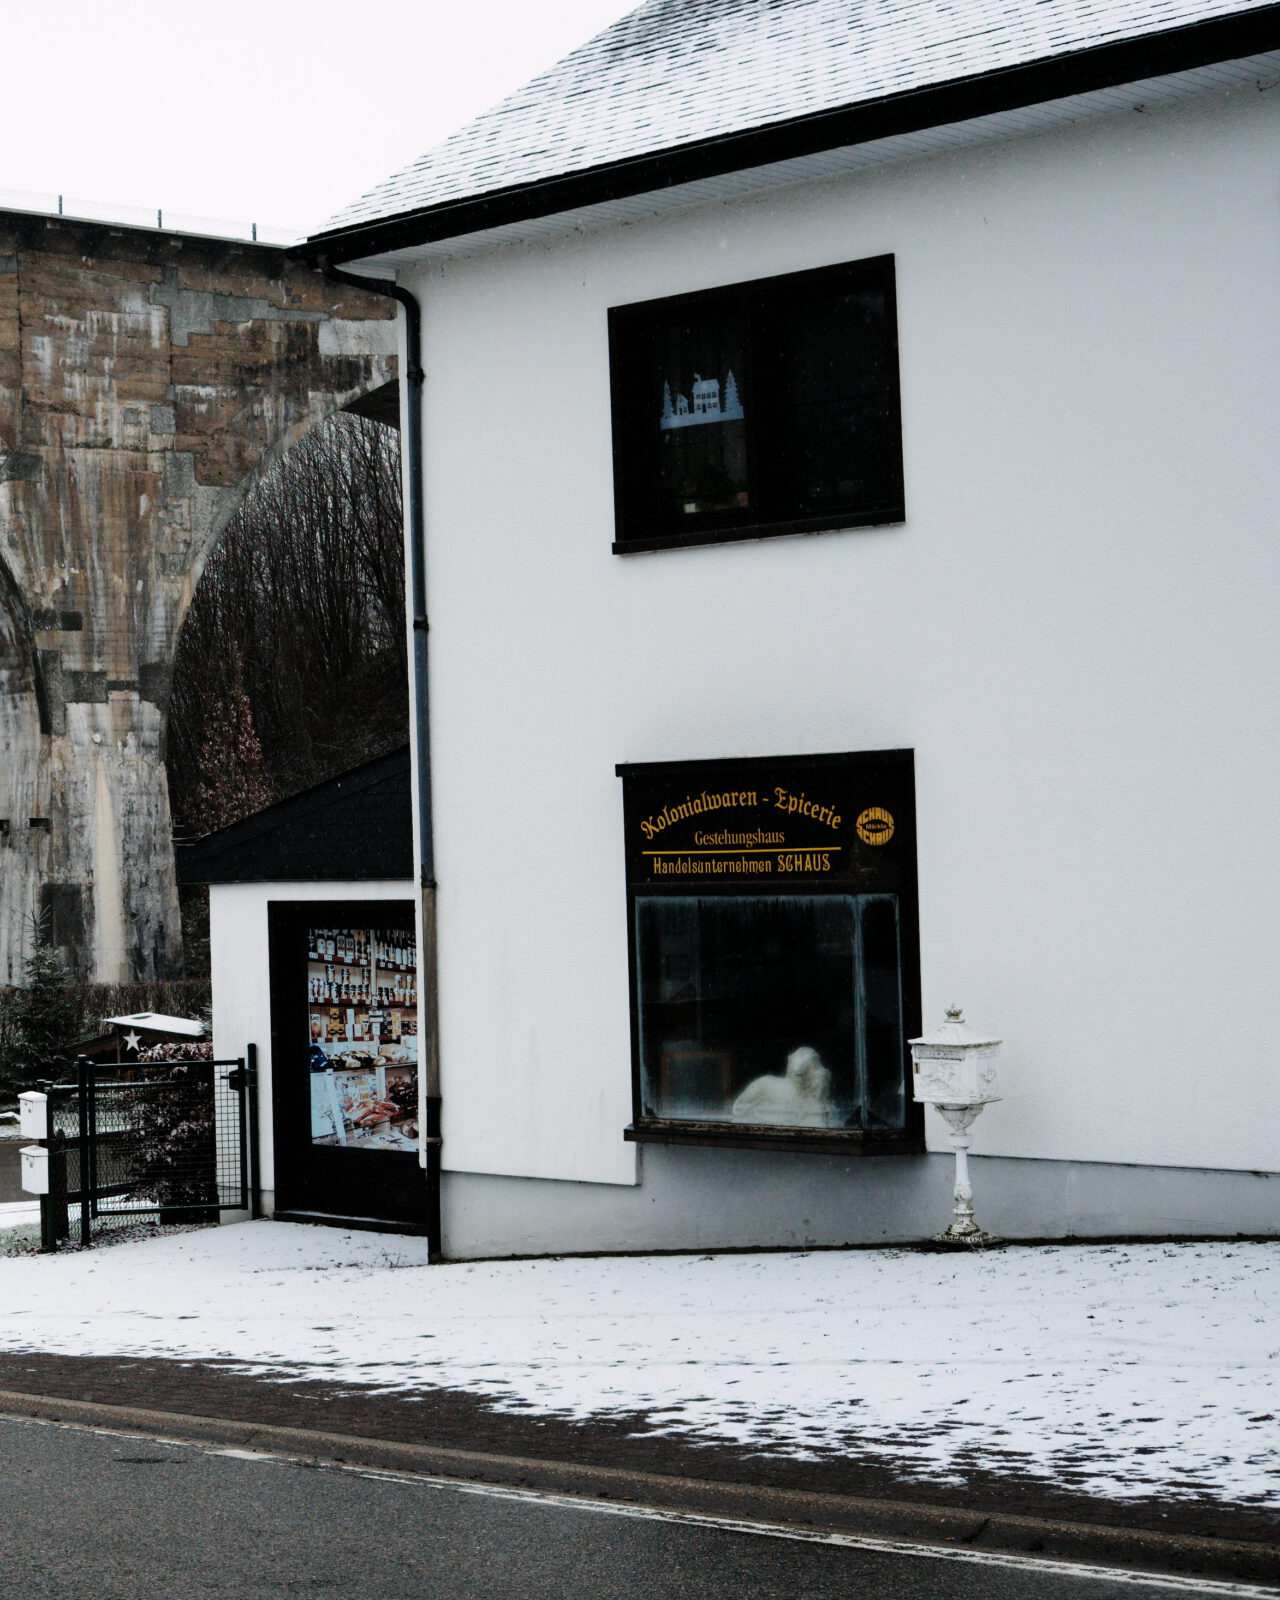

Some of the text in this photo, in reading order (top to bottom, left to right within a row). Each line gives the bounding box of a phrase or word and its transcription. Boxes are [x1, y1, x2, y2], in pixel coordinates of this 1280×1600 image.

[640, 790, 757, 840] Kolonialwaren
[774, 786, 841, 829] Epicerie
[694, 828, 785, 848] Gestehungshaus
[653, 853, 831, 875] Handelsunternehmen SCHAUS
